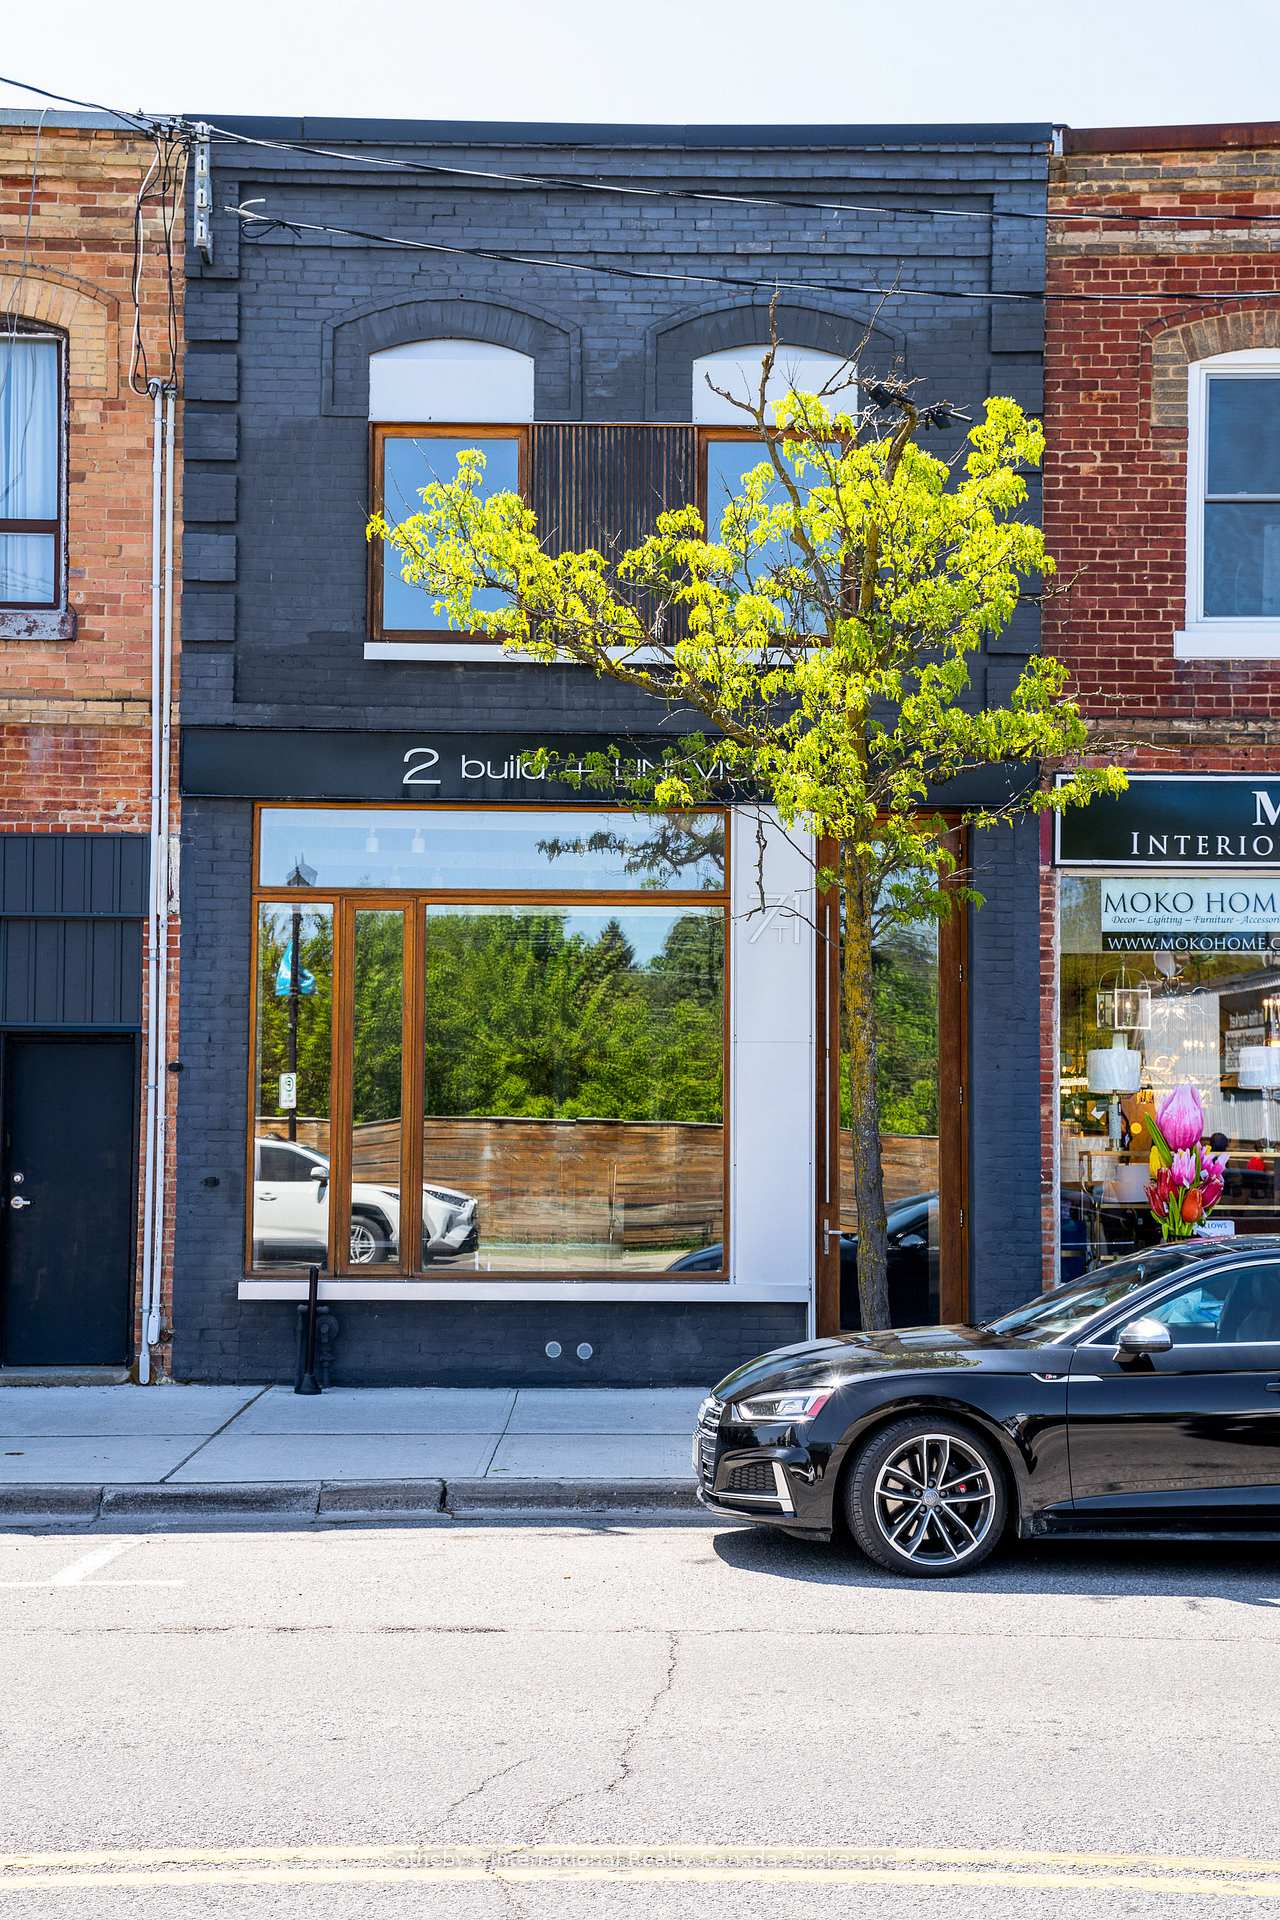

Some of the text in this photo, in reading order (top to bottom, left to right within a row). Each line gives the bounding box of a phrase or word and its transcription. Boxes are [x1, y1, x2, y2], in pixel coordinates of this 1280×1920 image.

[402, 747, 441, 785] 2
[460, 754, 546, 780] build
[1130, 831, 1275, 856] INTERIO
[1103, 891, 1277, 914] MOKO HOM
[1111, 914, 1137, 924] Decor
[1147, 914, 1183, 927] Lighting
[1193, 914, 1234, 924] Furniture
